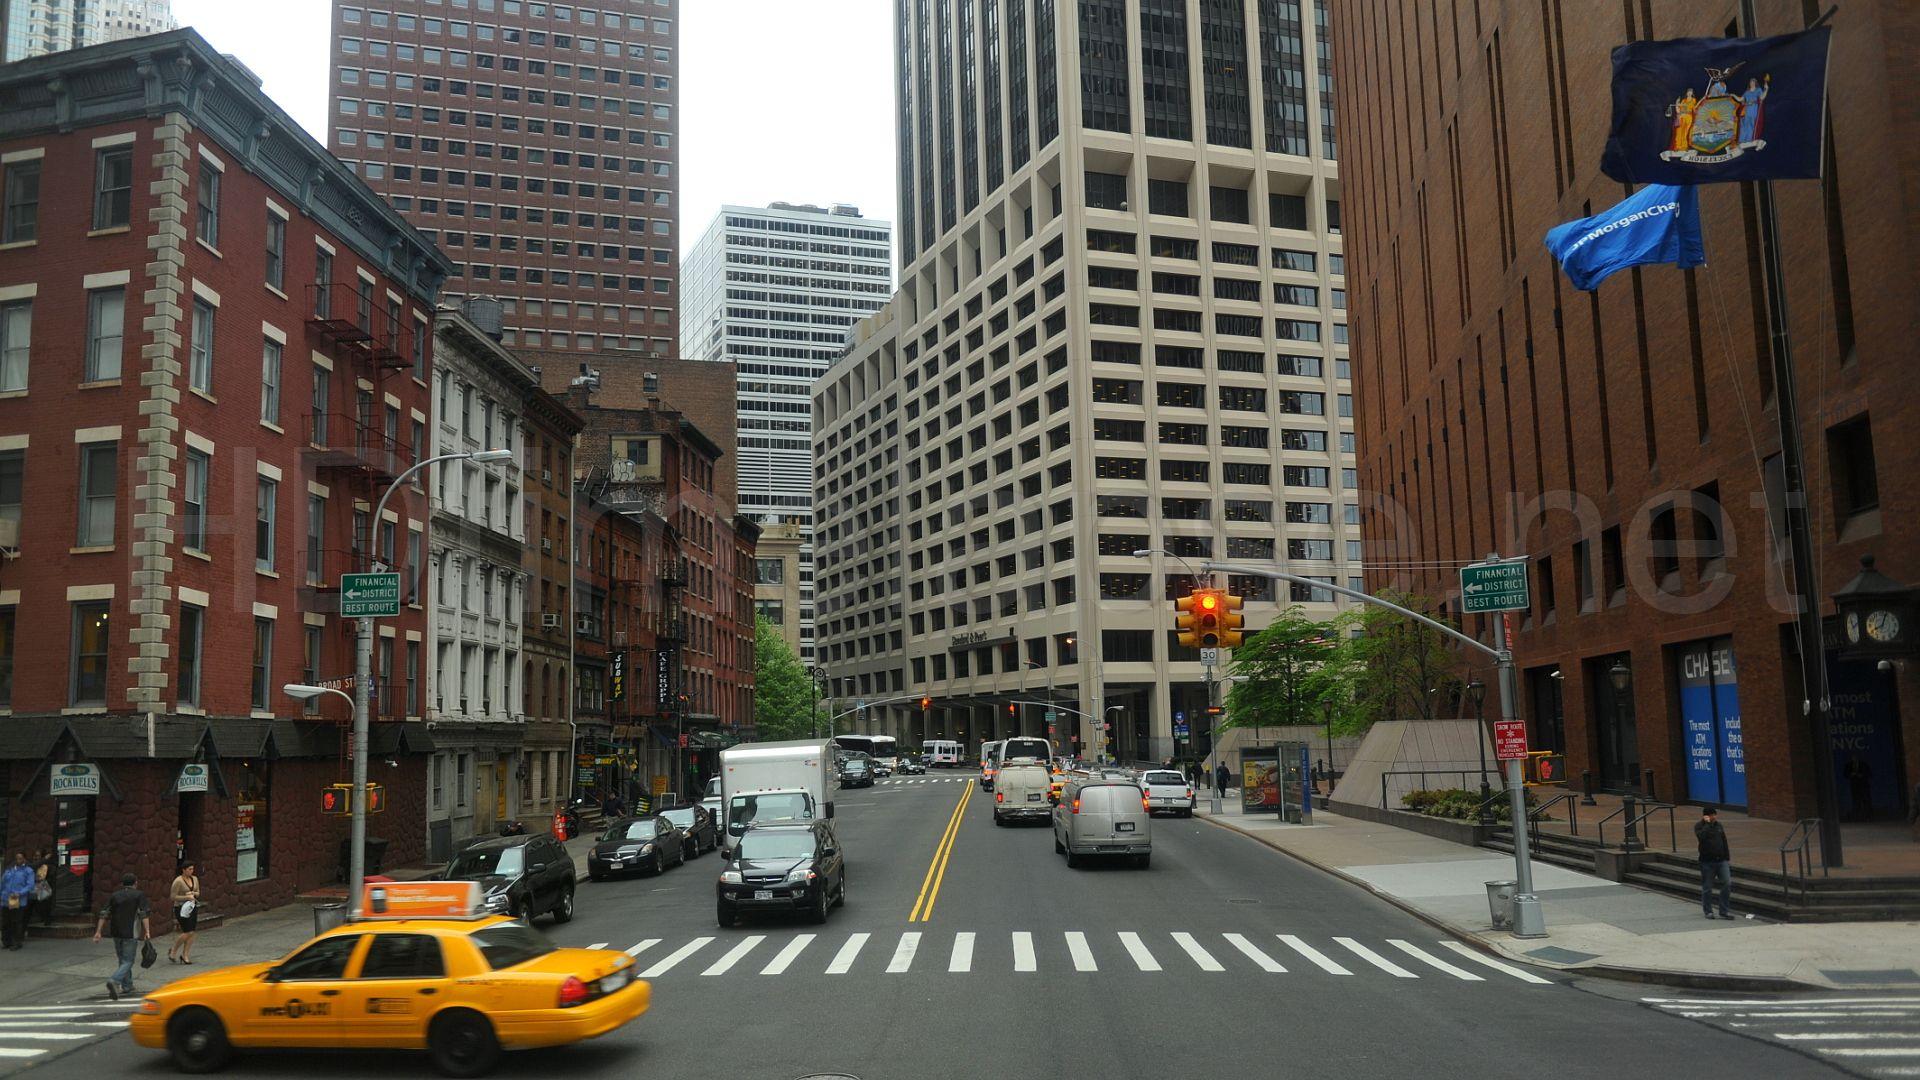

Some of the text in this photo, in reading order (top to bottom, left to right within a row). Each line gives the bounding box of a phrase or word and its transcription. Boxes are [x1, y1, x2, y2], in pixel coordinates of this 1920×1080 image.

[1476, 567, 1522, 580] FINANCIAL
[355, 577, 397, 587] FINANCIAL
[1484, 579, 1523, 592] DISTRICT
[362, 588, 397, 598] DISTRICT
[1468, 594, 1524, 608] BEST ROUTE
[345, 603, 395, 613] BEST ROUTE
[1202, 651, 1215, 659] 30
[1684, 649, 1731, 679] CHASE
[614, 654, 622, 698] SUBWAY
[345, 677, 354, 688] ST
[1835, 692, 1873, 704] most
[1688, 719, 1710, 731] The most
[1830, 721, 1874, 735] ations
[1695, 733, 1706, 745] ATM
[1691, 745, 1712, 757] locations
[1699, 759, 1711, 771] NYC.
